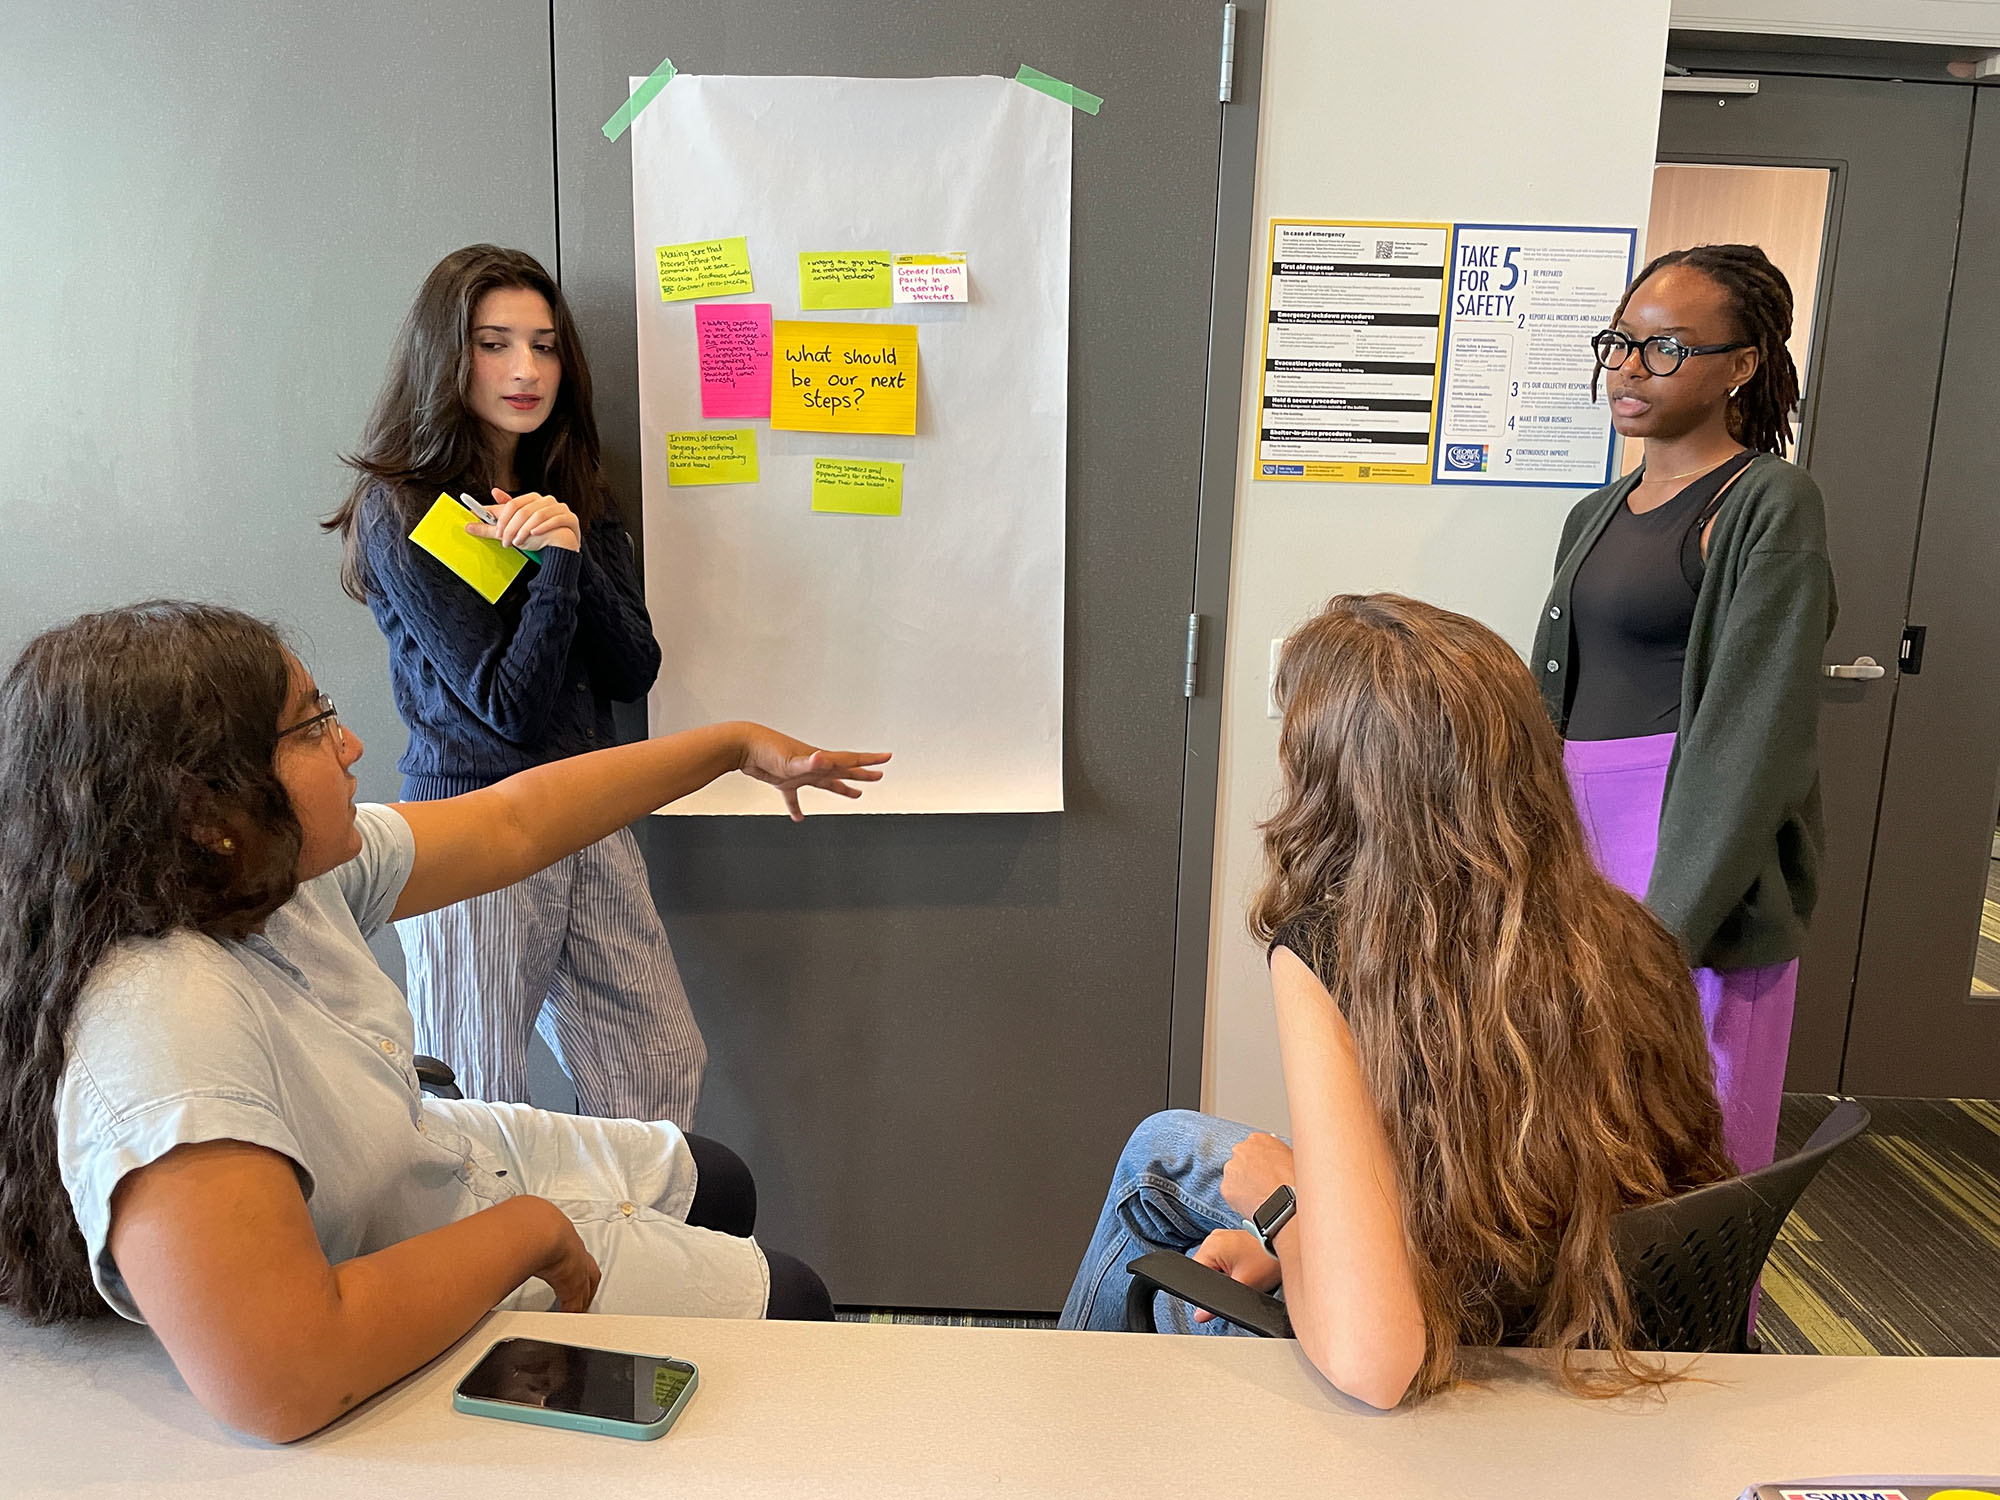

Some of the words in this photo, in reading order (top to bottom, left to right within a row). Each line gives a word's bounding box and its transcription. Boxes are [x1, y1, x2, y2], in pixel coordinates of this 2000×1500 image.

[1306, 264, 1334, 272] response
[1461, 245, 1499, 268] TAKE
[1500, 247, 1521, 291] 5
[1458, 270, 1489, 292] FOR
[1523, 270, 1528, 285] 1
[1540, 270, 1563, 278] PREPARED
[901, 285, 950, 293] leadership
[1456, 294, 1515, 317] SAFETY
[1277, 311, 1311, 319] Emergency
[1518, 313, 1526, 329] 2
[843, 347, 897, 365] should
[792, 368, 811, 387] be
[828, 374, 858, 386] our
[871, 371, 907, 388] next
[1511, 381, 1519, 397] 3
[1508, 416, 1515, 430] 4
[1505, 449, 1513, 464] 5
[1550, 449, 1569, 457] IMPROVE
